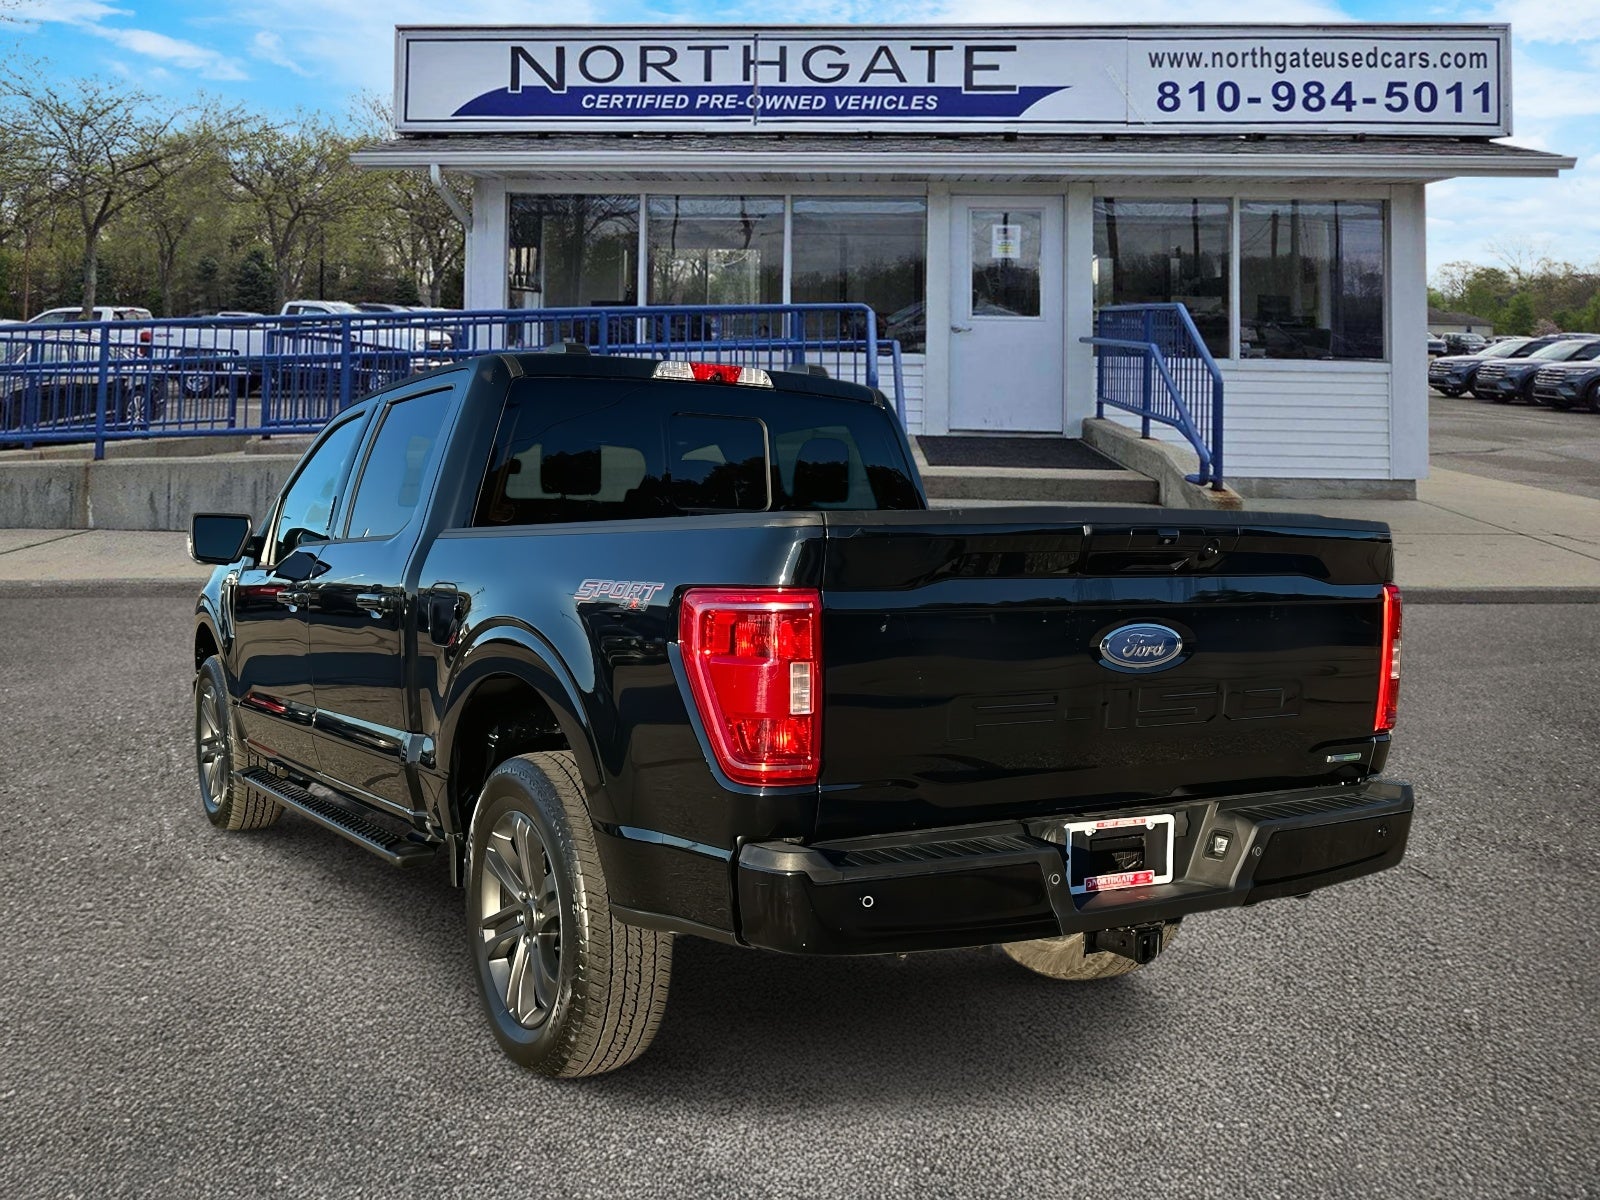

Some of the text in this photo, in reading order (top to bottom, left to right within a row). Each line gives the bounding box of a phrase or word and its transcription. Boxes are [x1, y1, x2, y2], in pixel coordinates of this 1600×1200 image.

[510, 44, 1017, 93] NORTHGATE
[1149, 46, 1488, 74] www.northgateusedcars.com
[582, 94, 938, 110] CERTIFIED PRE-OWNED VEHICLES
[1156, 81, 1490, 113] 810-984-5011
[574, 579, 665, 600] SPORT
[1122, 633, 1166, 657] Ford
